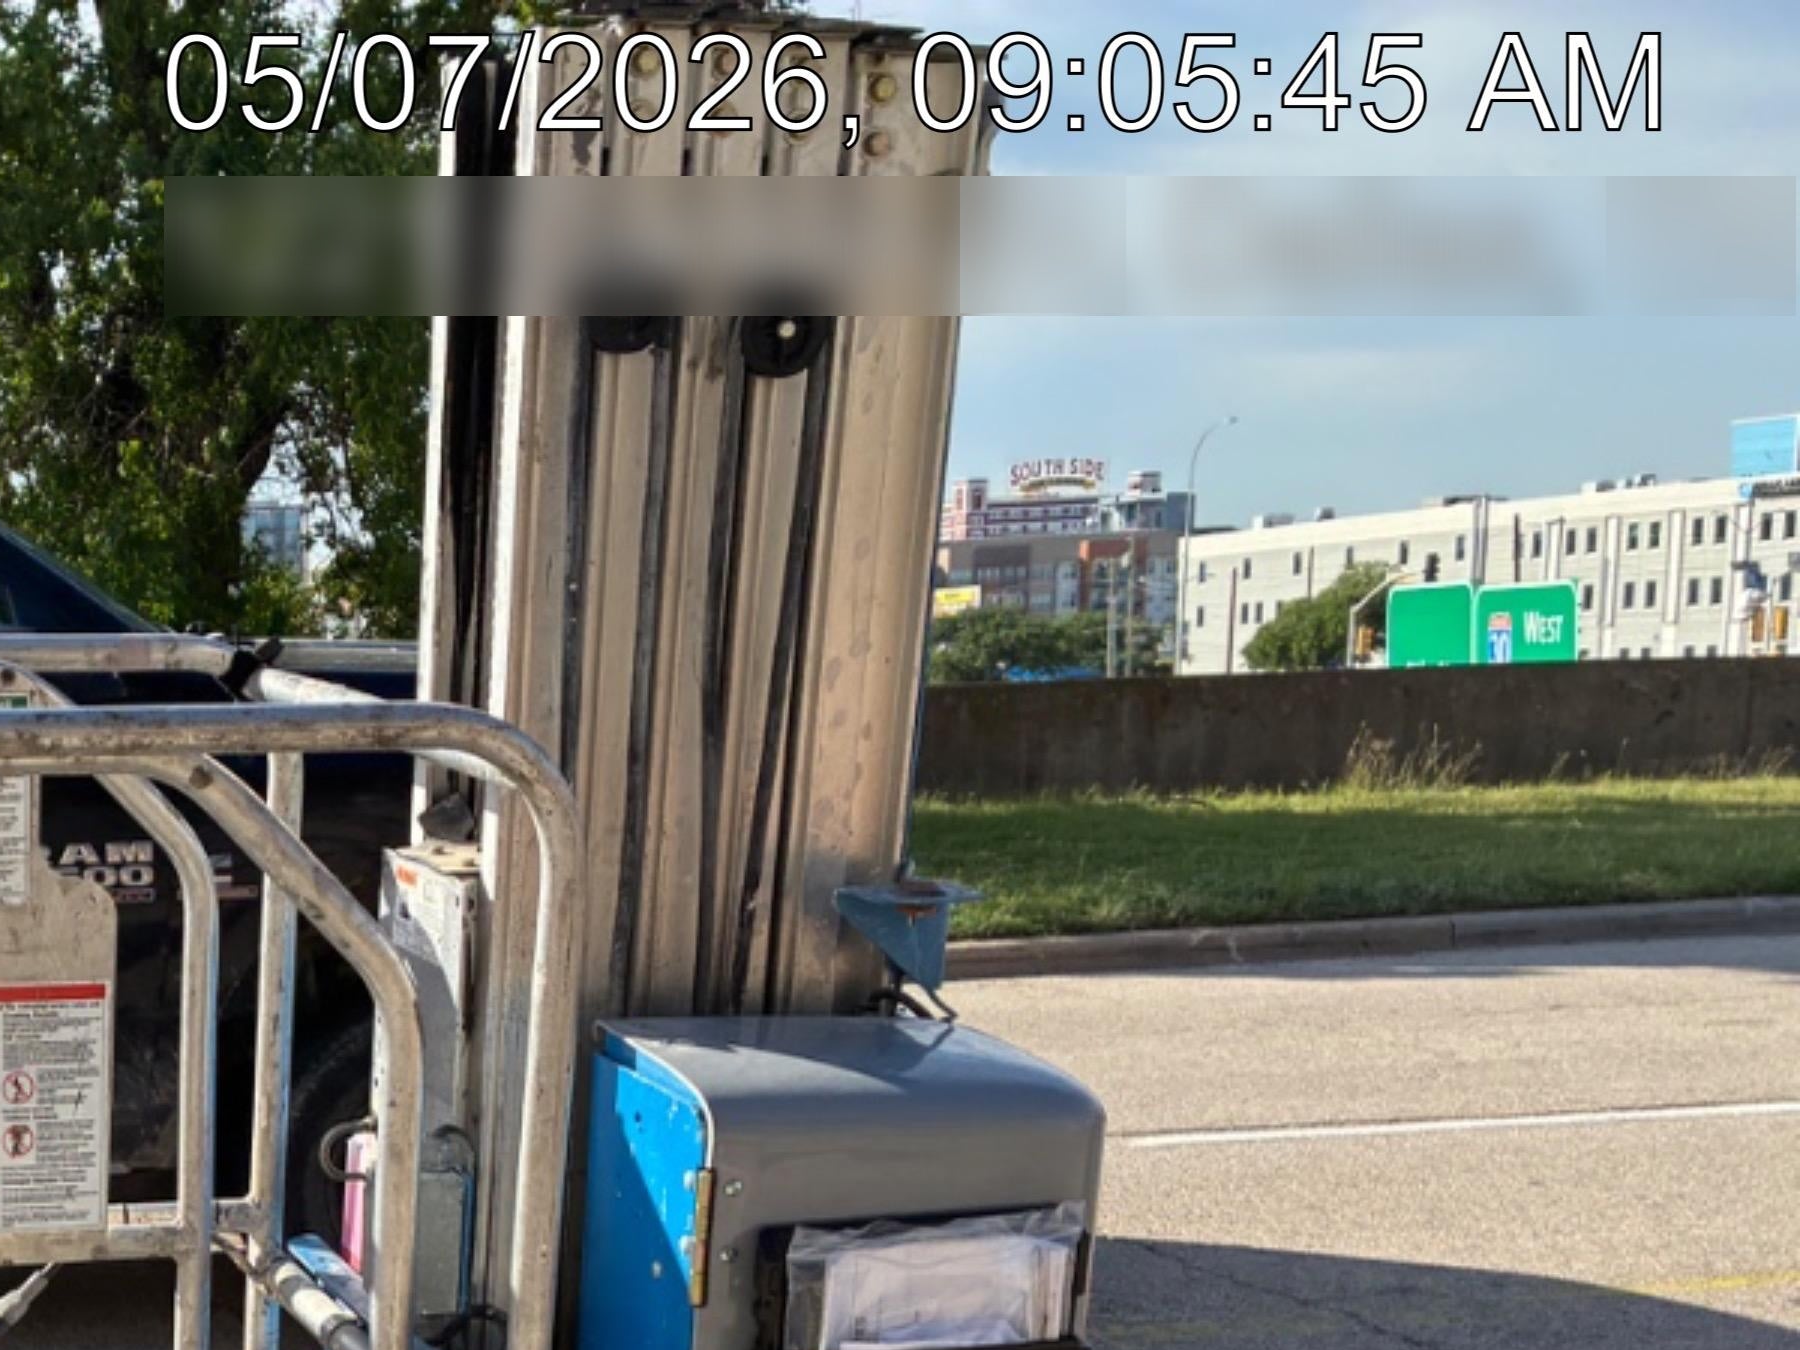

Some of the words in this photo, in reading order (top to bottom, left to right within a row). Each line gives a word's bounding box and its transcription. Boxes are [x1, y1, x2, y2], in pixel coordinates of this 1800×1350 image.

[1009, 458, 1065, 487] SOUTH
[1070, 458, 1105, 481] SIDE
[57, 840, 154, 864] AM
